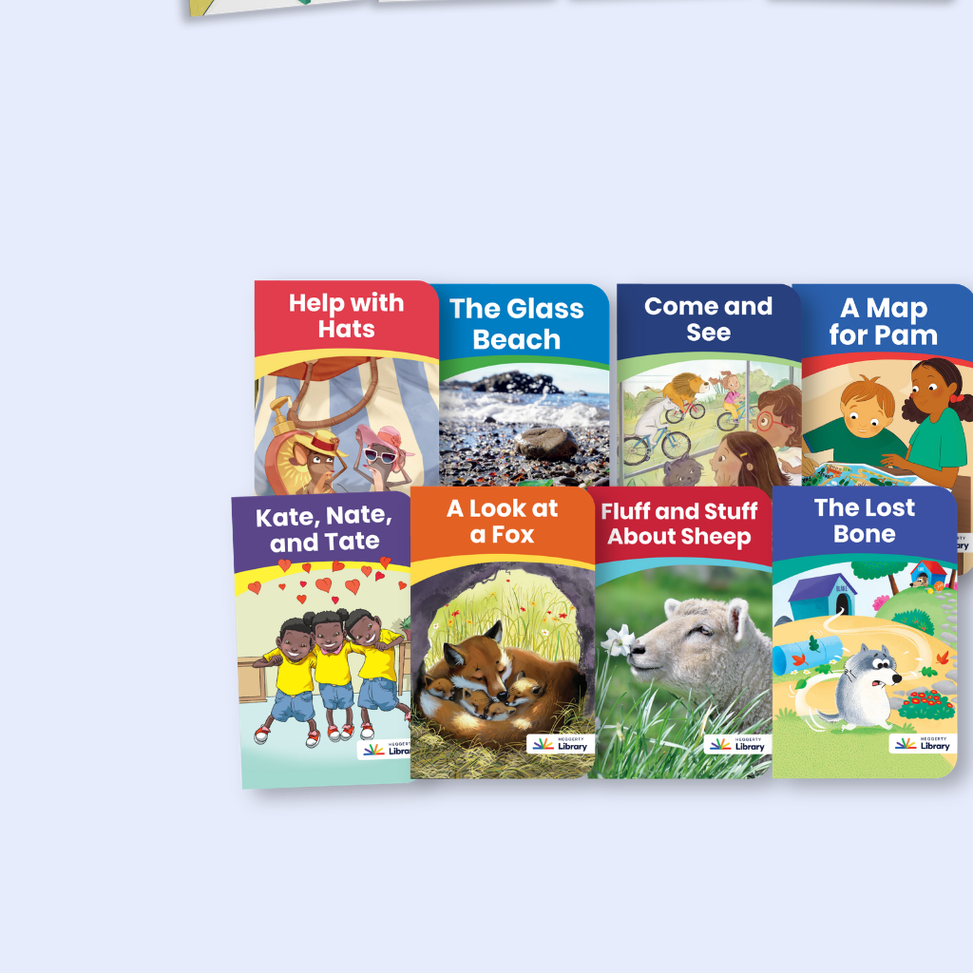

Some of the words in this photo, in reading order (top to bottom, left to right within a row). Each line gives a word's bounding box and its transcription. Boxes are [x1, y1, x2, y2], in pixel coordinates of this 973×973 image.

[289, 292, 345, 319] Help
[350, 291, 404, 312] with
[449, 297, 501, 319] The
[507, 297, 584, 319] Glass
[644, 296, 719, 316] Come
[724, 296, 773, 316] and
[840, 297, 860, 318] A
[867, 297, 928, 325] Map
[318, 319, 375, 338] Hats
[687, 322, 731, 342] See
[829, 322, 868, 346] for
[875, 324, 938, 346] Pam
[473, 328, 561, 350] Beach
[256, 508, 320, 529] Kate,
[326, 505, 392, 526] Nate,
[446, 499, 464, 518] A
[470, 498, 527, 518] Look
[532, 499, 558, 518] at
[601, 501, 651, 520] Fluff
[655, 502, 699, 520] and
[704, 501, 758, 520] Stuff
[813, 497, 860, 517] The
[865, 498, 916, 517] Lost
[270, 532, 319, 553] and
[324, 531, 380, 551] Tate
[470, 528, 486, 544] a
[492, 525, 535, 544] Fox
[607, 527, 676, 545] About
[681, 527, 752, 551] Sheep
[834, 524, 896, 543] Bone
[558, 742, 588, 752] Library
[735, 742, 765, 752] Library
[920, 742, 950, 751] Library
